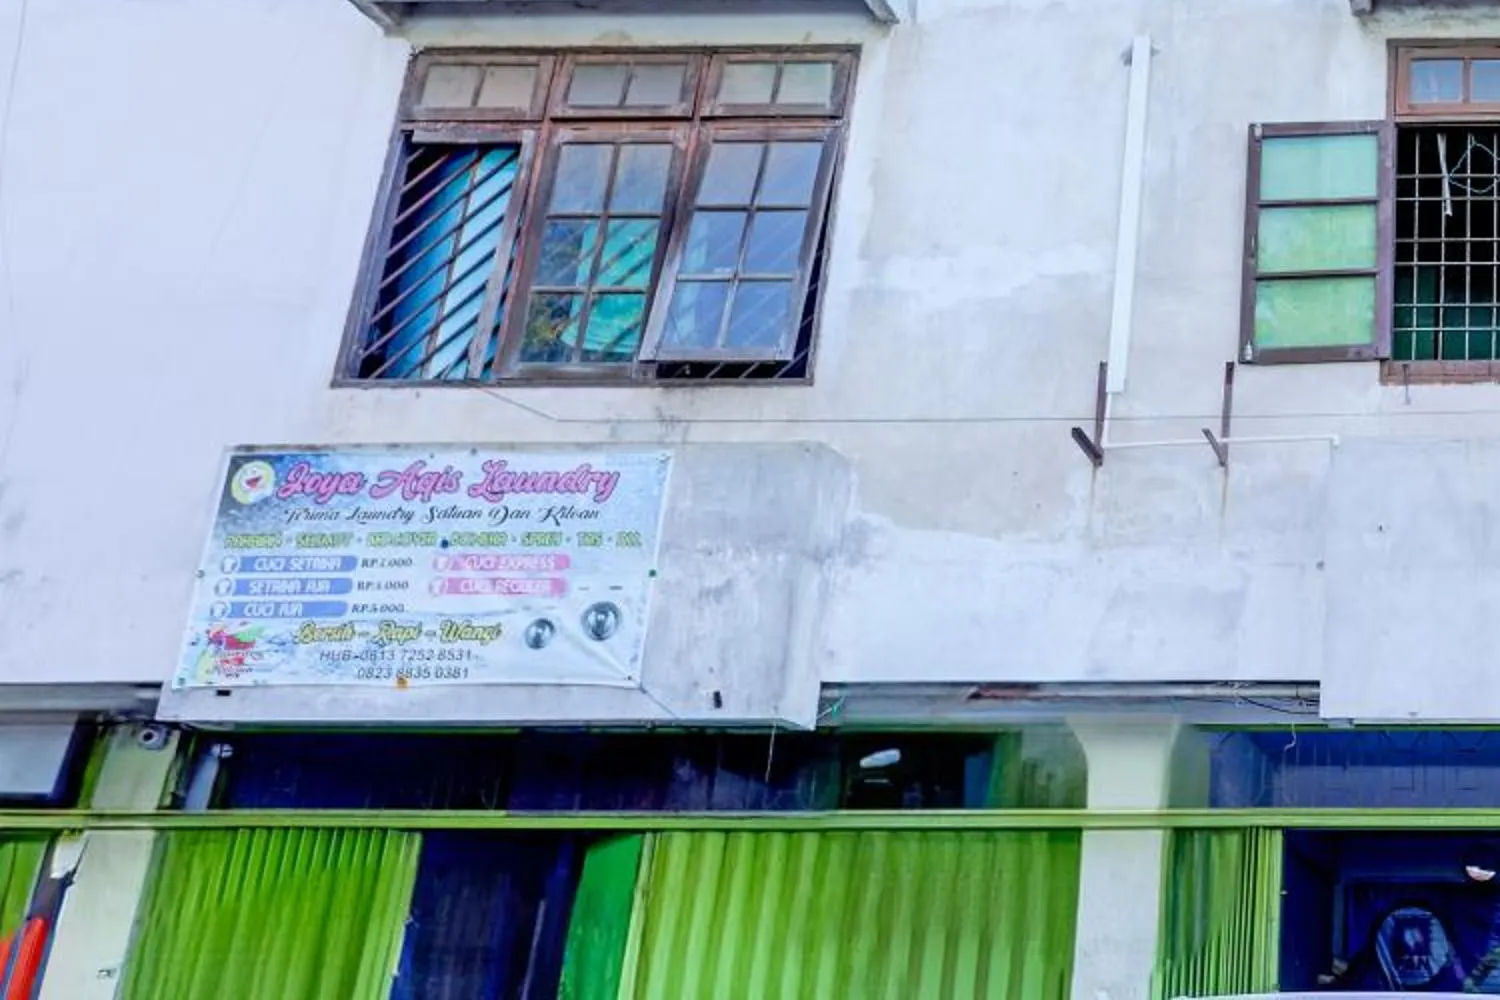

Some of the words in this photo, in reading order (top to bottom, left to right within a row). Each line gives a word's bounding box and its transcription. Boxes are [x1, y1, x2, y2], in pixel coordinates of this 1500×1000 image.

[467, 459, 620, 503] Laundry
[345, 506, 414, 524] Laundry
[421, 505, 482, 525] Satuan
[487, 505, 530, 526] Dan
[538, 505, 600, 526] Kiloan
[254, 557, 285, 571] CUCI
[464, 556, 494, 570] CUCI
[460, 580, 491, 594] CUCI
[243, 602, 275, 617] CUCI
[294, 620, 356, 645] Bersih
[370, 620, 422, 647] Rapi
[438, 619, 503, 646] Wangi
[356, 667, 393, 680] 0823
[434, 667, 470, 680] 0381
